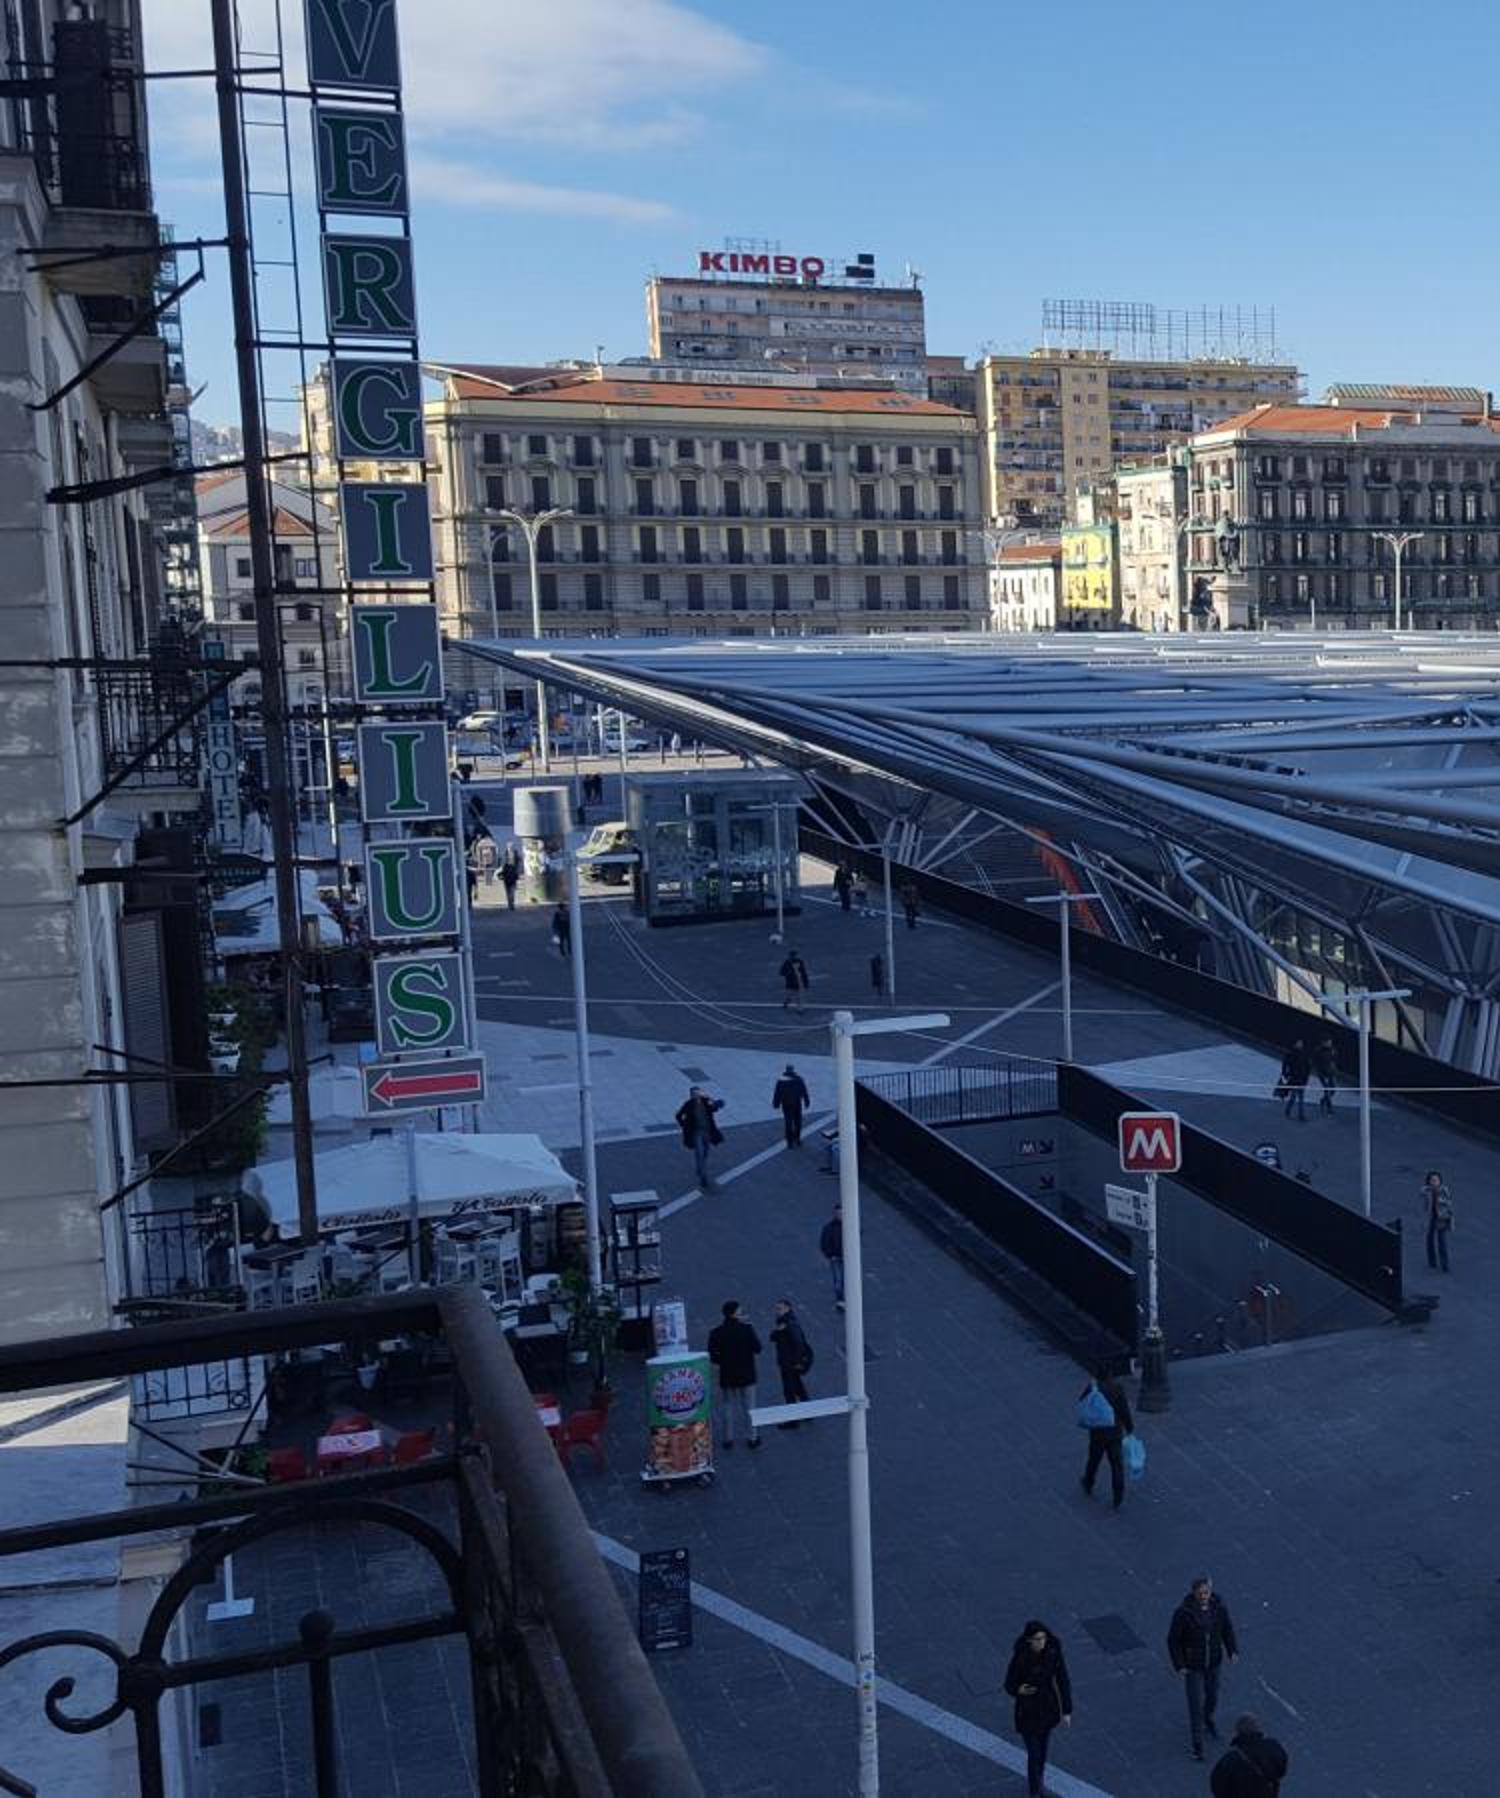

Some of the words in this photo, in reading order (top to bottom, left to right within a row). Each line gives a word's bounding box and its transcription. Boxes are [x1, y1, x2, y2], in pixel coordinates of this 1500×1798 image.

[700, 251, 825, 278] KIMBO
[317, 0, 456, 1047] VERGILIUS
[211, 725, 239, 848] HOTEL
[1127, 1126, 1172, 1160] M
